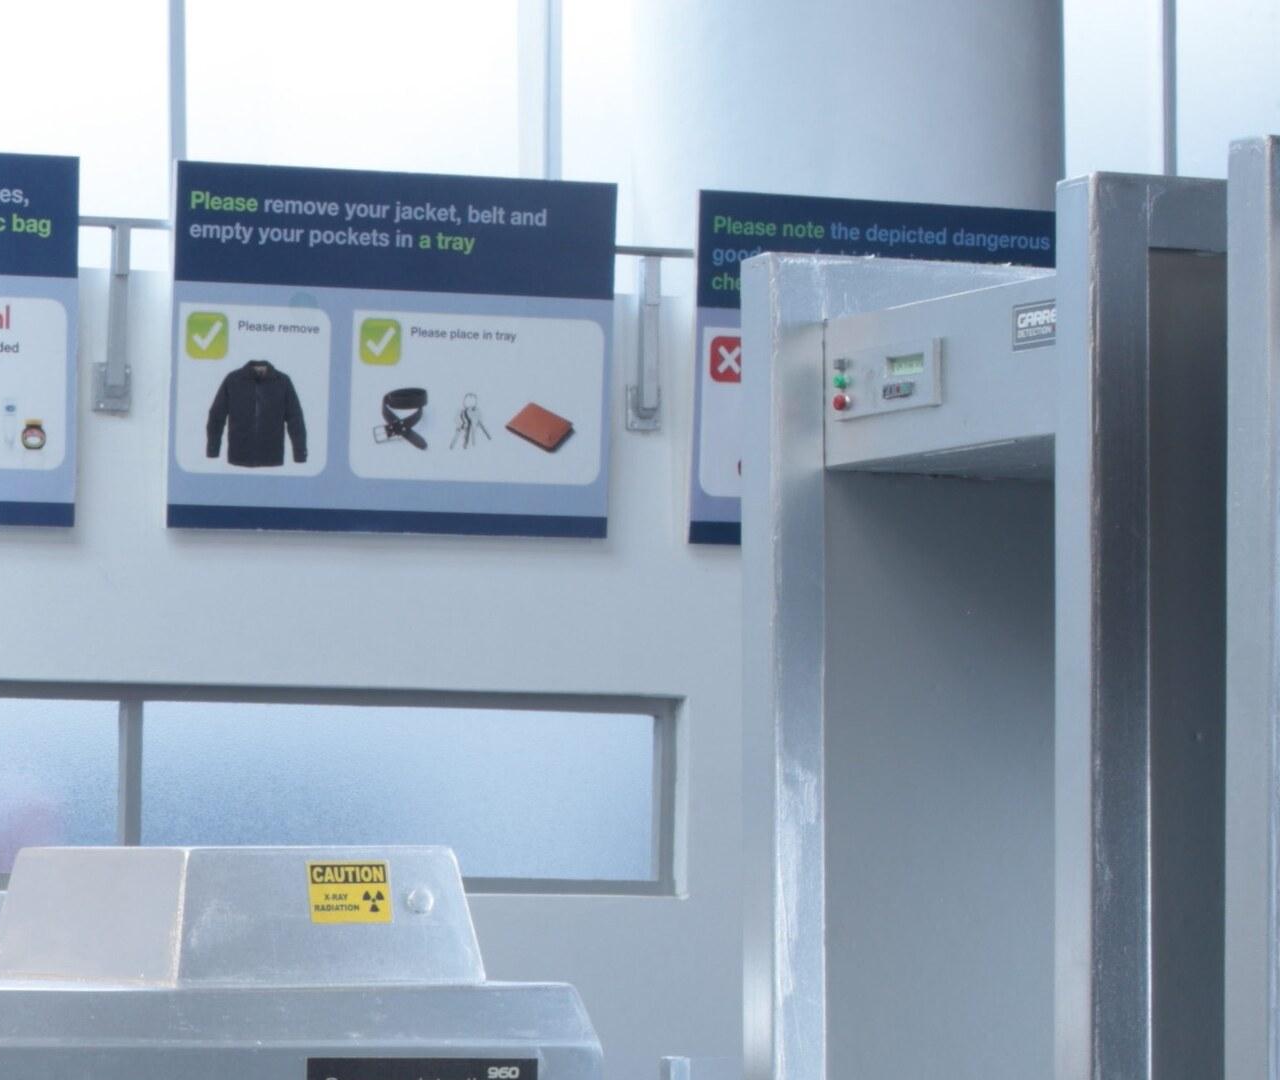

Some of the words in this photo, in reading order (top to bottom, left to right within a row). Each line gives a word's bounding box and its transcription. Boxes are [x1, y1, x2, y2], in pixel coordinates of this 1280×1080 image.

[190, 191, 258, 212] Please
[264, 198, 339, 216] remove
[345, 203, 389, 220] your
[394, 202, 462, 225] jacket,
[468, 205, 504, 224] belt
[510, 209, 547, 226] and
[12, 214, 51, 237] bag
[713, 216, 777, 236] Please
[782, 222, 825, 239] note
[830, 222, 860, 240] the
[866, 224, 947, 246] depicted
[953, 228, 1050, 251] dangerous
[190, 223, 252, 243] empty
[258, 226, 304, 244] your
[309, 227, 389, 247] pockets
[396, 231, 412, 248] in
[419, 234, 430, 248] a
[436, 234, 475, 254] tray
[238, 321, 274, 332] Please
[278, 324, 320, 334] remove
[1018, 309, 1056, 328] GARRE
[411, 327, 446, 339] Please
[449, 329, 480, 341] place
[483, 330, 492, 340] in
[495, 332, 516, 343] tray
[312, 866, 384, 882] CAUTION
[488, 1067, 519, 1079] 960
